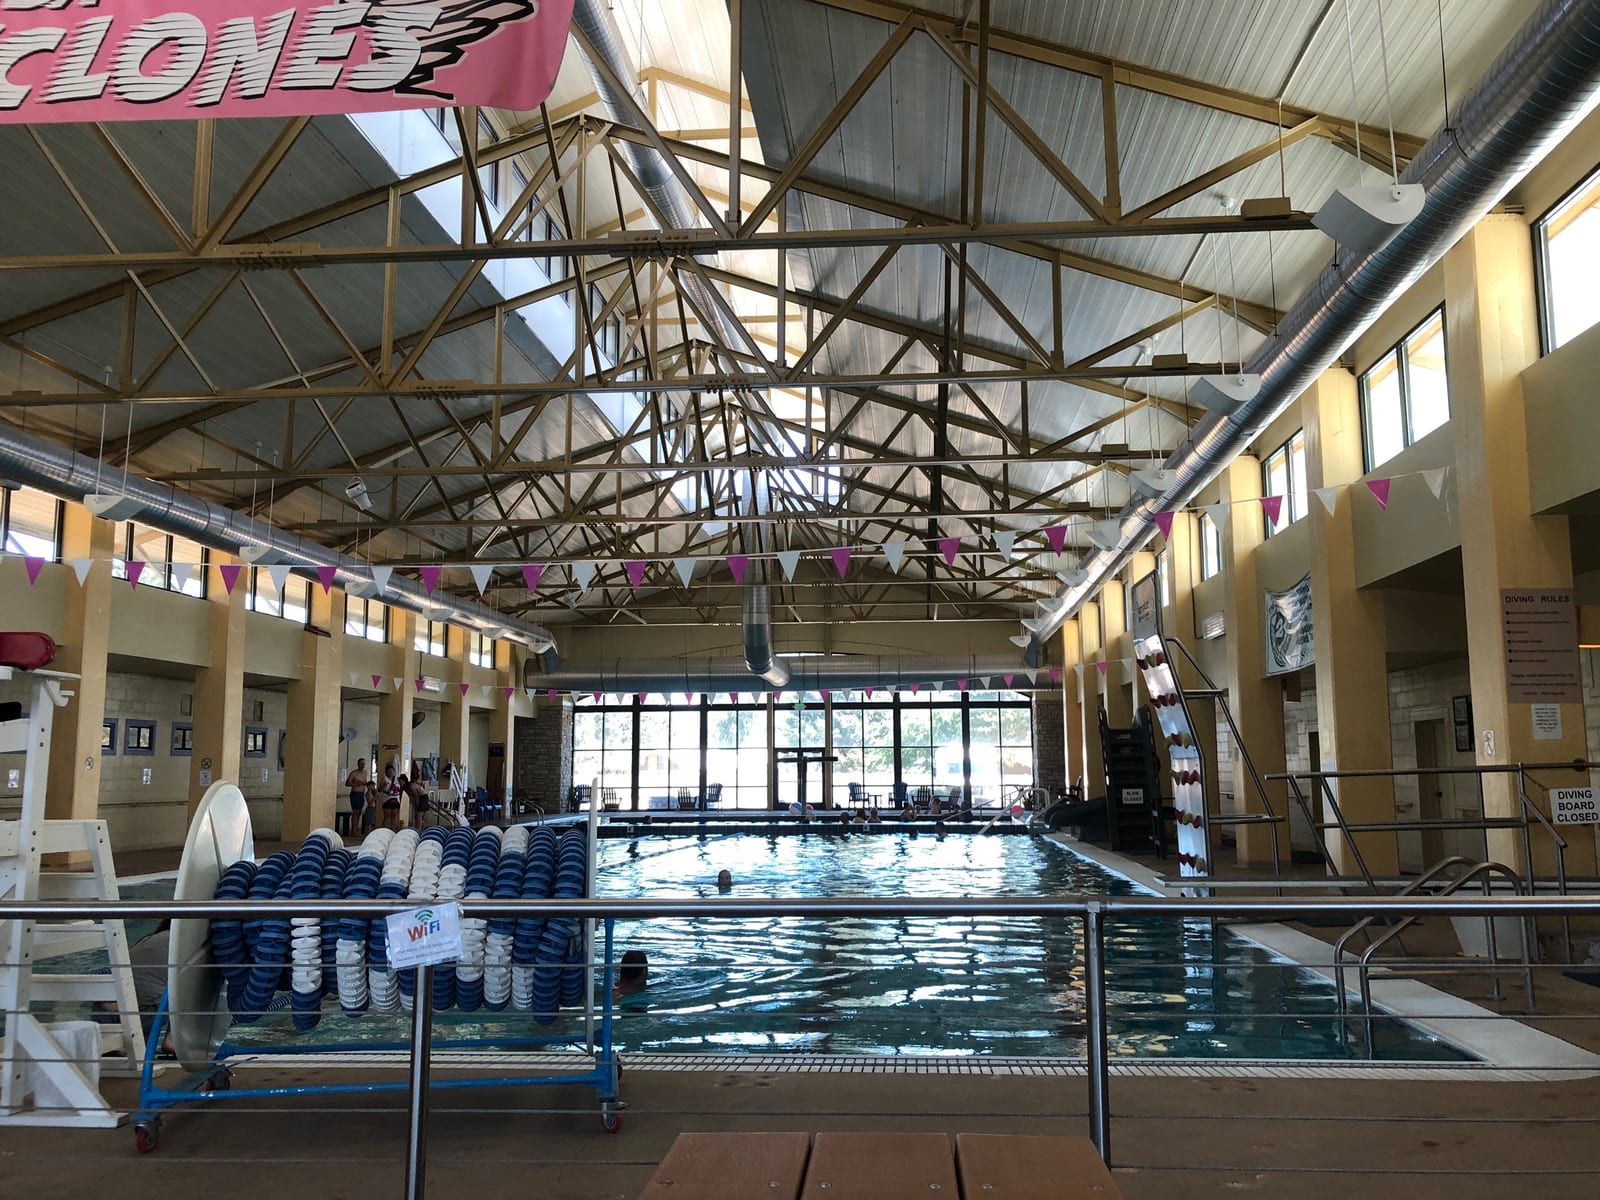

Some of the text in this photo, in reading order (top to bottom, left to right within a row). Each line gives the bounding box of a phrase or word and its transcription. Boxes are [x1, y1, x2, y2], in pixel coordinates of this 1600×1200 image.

[0, 1, 442, 110] CLONES
[1504, 595, 1570, 603] DIVING RULES
[1557, 790, 1593, 800] DIVING
[1558, 801, 1595, 811] BOARD
[1557, 812, 1599, 822] CLOSED
[407, 919, 440, 942] WiFi
